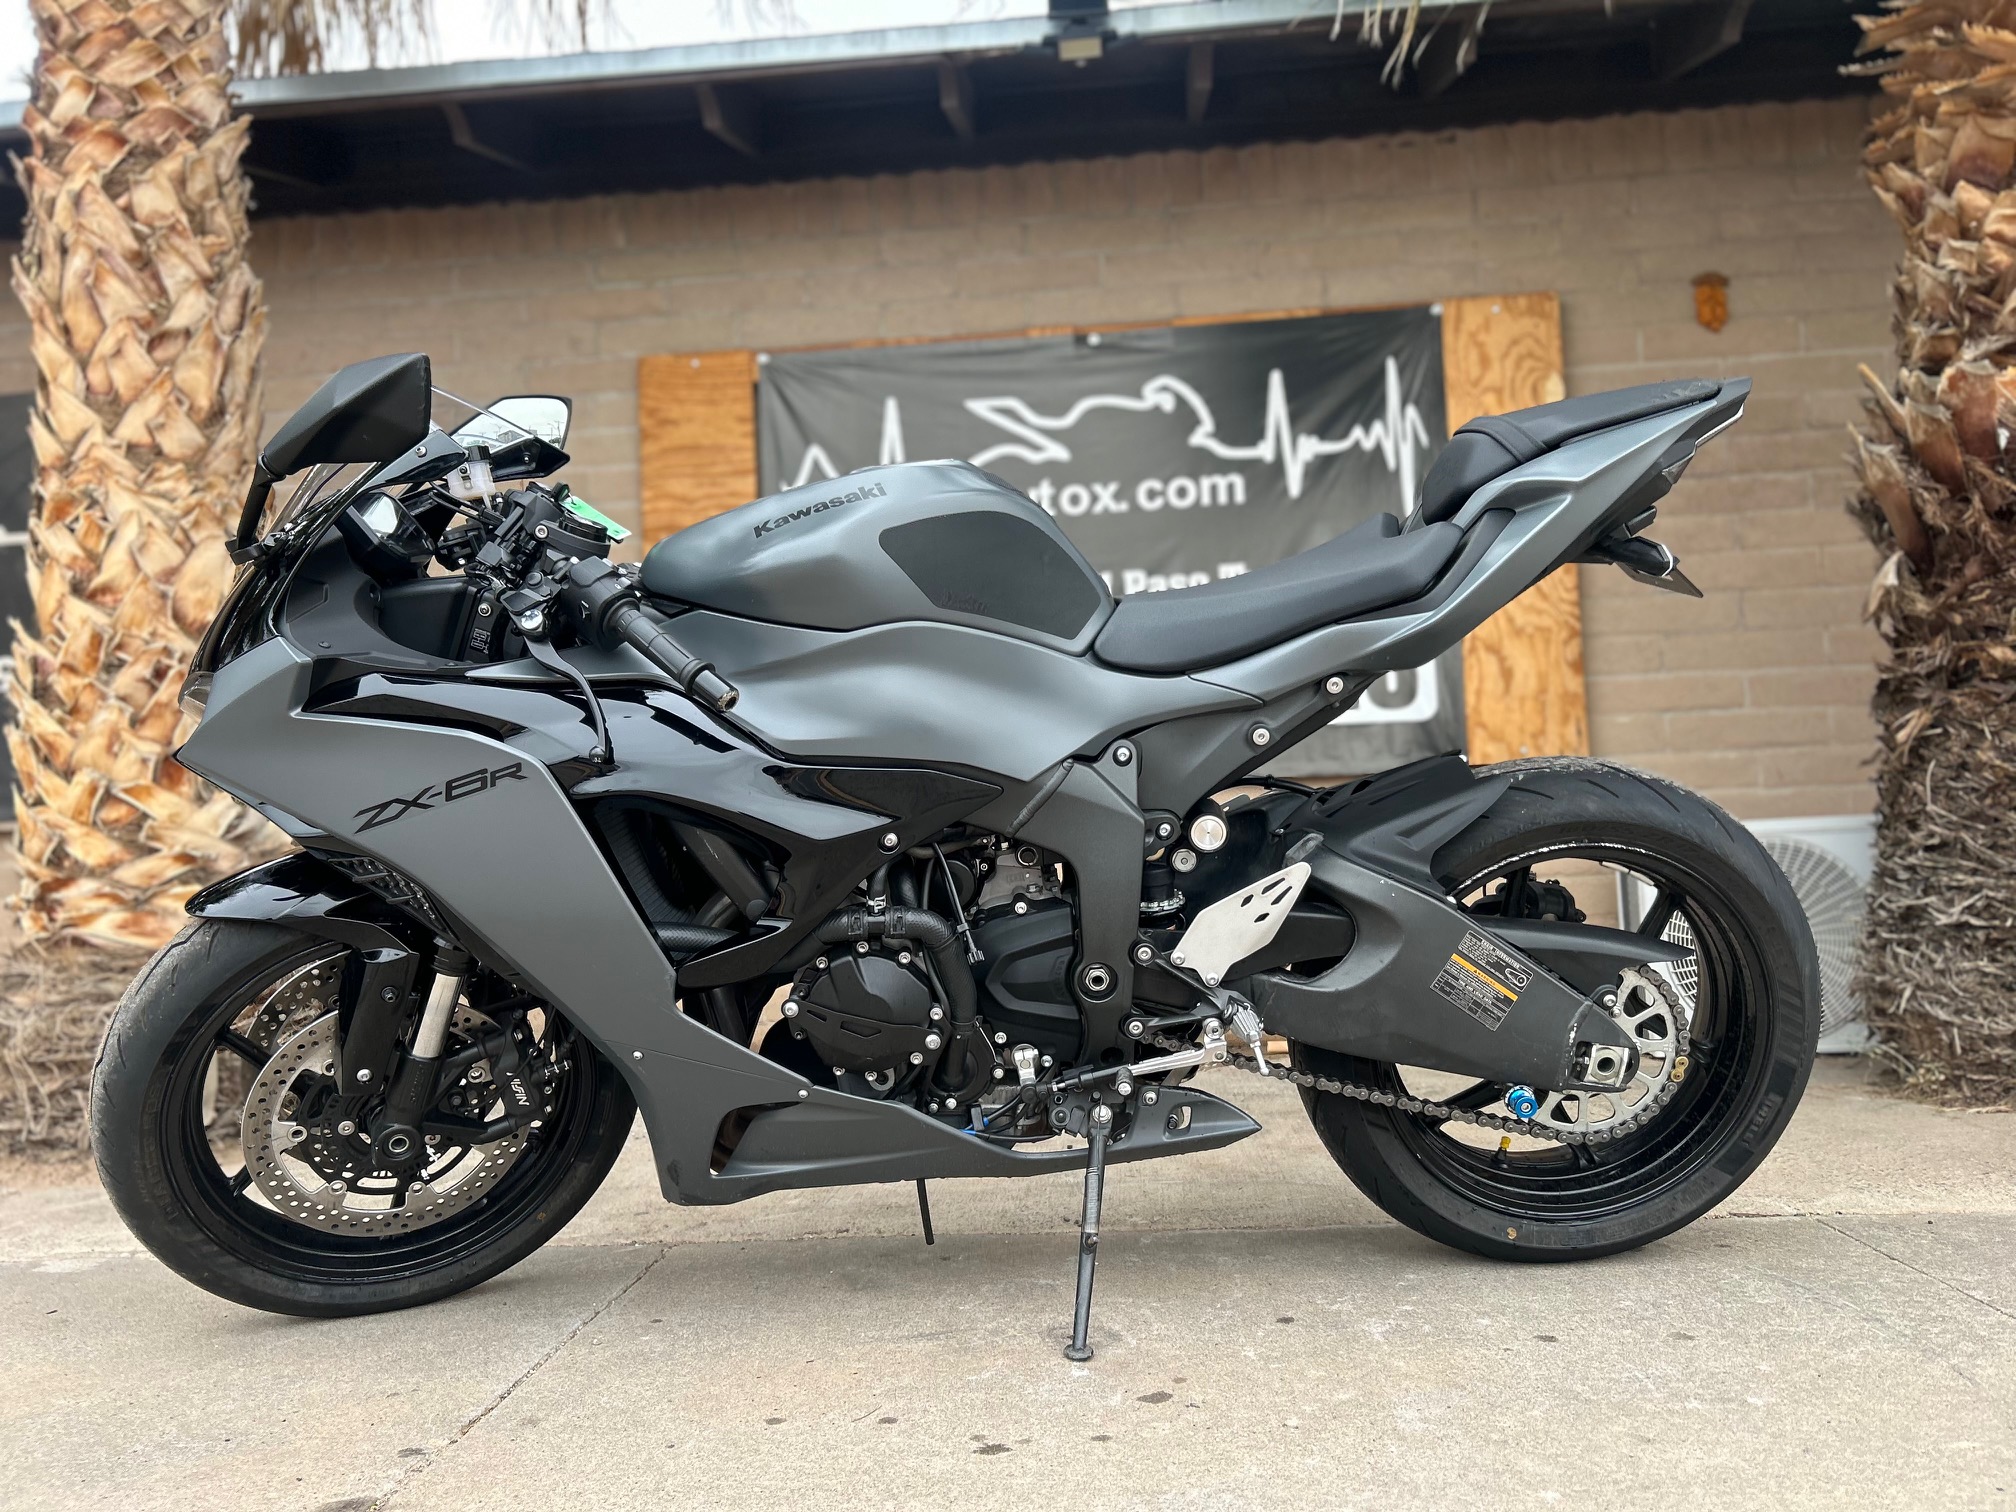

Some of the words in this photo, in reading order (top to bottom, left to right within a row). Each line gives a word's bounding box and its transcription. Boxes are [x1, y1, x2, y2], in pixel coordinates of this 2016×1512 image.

[753, 482, 887, 539] Kawasaki
[1029, 472, 1247, 517] tox.com
[353, 761, 528, 835] ZX-6R
